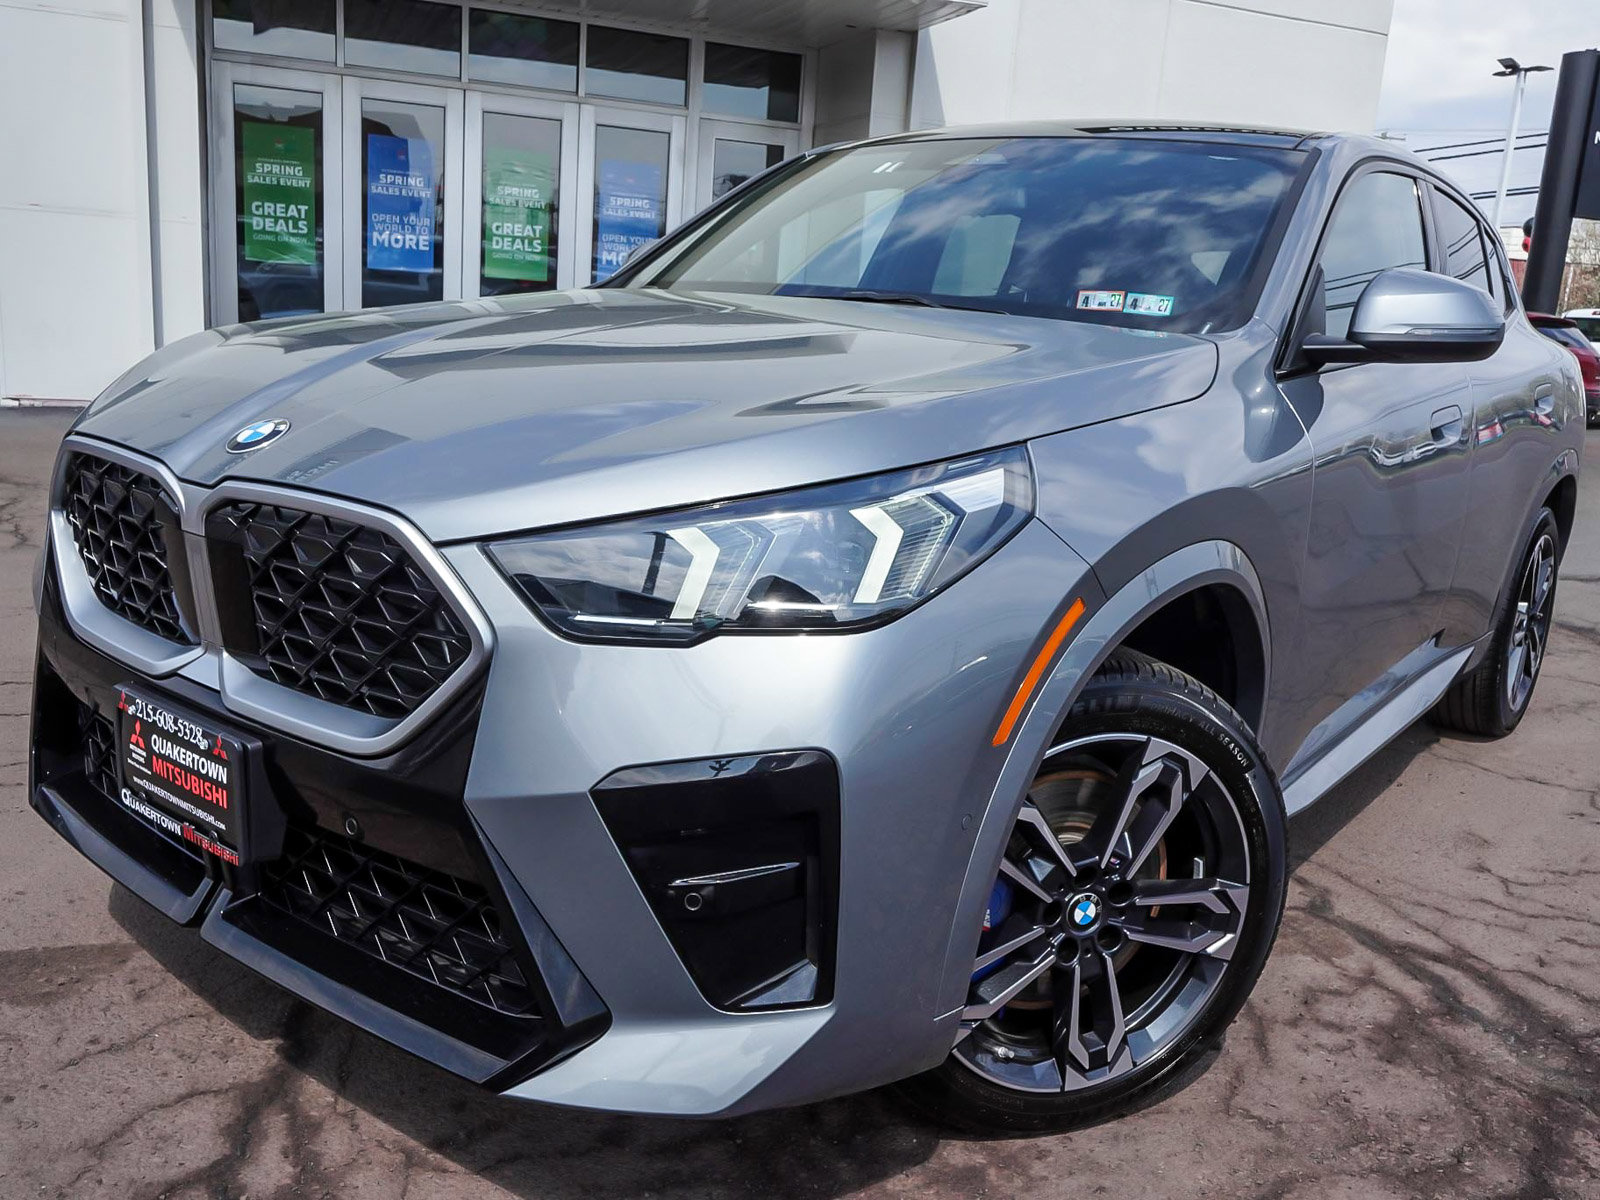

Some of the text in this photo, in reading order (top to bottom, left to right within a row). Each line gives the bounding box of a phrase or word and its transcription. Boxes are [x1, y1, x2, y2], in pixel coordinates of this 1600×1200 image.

[256, 163, 304, 177] SPRING
[248, 176, 311, 188] SALES EVENT
[380, 174, 424, 188] SPRING
[372, 186, 432, 199] SALES EVENT
[498, 186, 540, 199] SPRING
[490, 198, 546, 209] SALES EVENT
[610, 197, 650, 209] SPRING
[252, 202, 308, 219] GREAT
[603, 208, 655, 219] SALES EVENT
[253, 217, 308, 234] DEALS
[373, 213, 431, 227] OPEN YOUR
[375, 223, 428, 236] WORLD TO
[492, 223, 543, 238] GREAT
[253, 234, 276, 242] GOING
[373, 232, 430, 251] MORE
[493, 237, 542, 253] DEALS
[603, 234, 627, 243] OPEN
[603, 251, 628, 266] MO
[1082, 297, 1090, 308] 4
[1111, 294, 1122, 308] 27
[1130, 299, 1171, 313] 4 27
[135, 699, 203, 745] 215-608-5328
[1200, 721, 1216, 737] ALL
[1219, 733, 1249, 767] SEASON
[151, 734, 228, 784] QUAKERTOWN
[152, 755, 228, 809] MITSUBISHI
